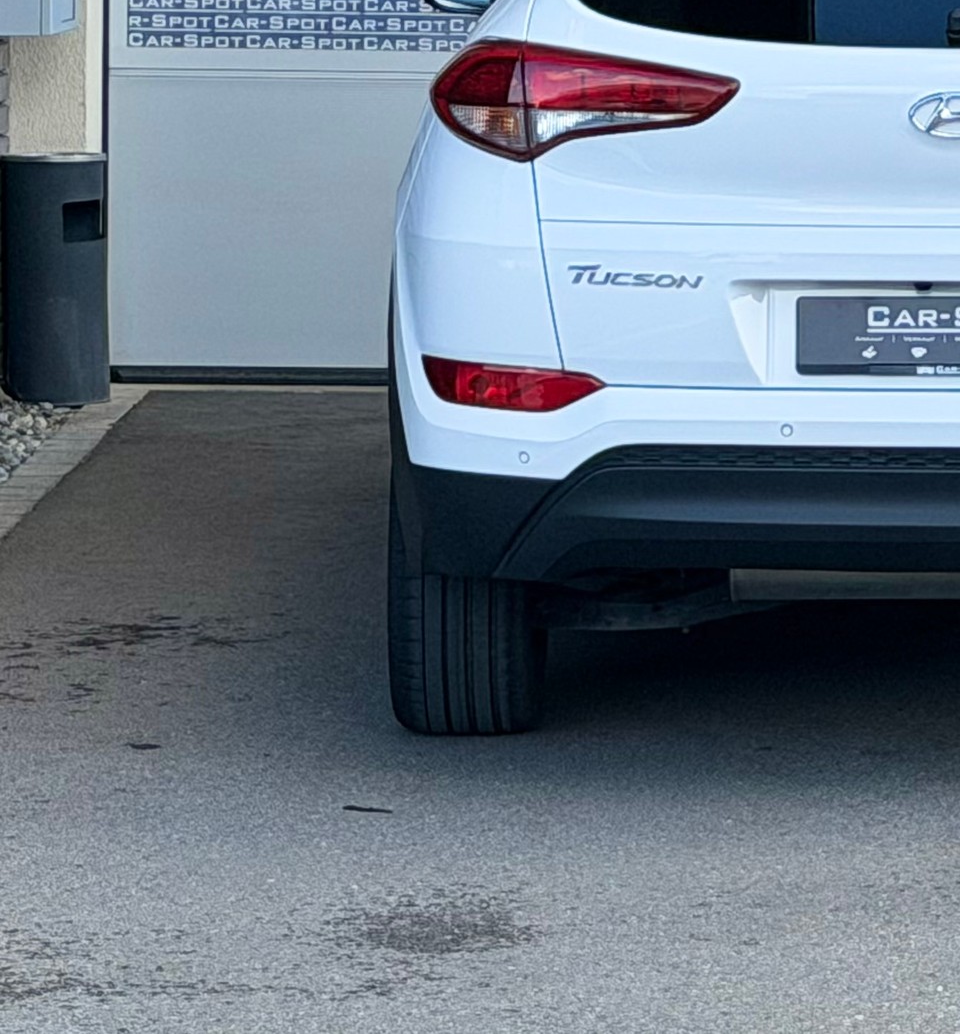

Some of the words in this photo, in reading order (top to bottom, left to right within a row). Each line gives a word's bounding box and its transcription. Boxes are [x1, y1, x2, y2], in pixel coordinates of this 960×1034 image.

[214, 14, 329, 30] CAR-SPOT
[332, 16, 447, 32] CAR-SPOT
[129, 32, 244, 48] CAR-SPOT
[247, 34, 362, 50] CAR-SPOT
[567, 264, 704, 289] TUCSON
